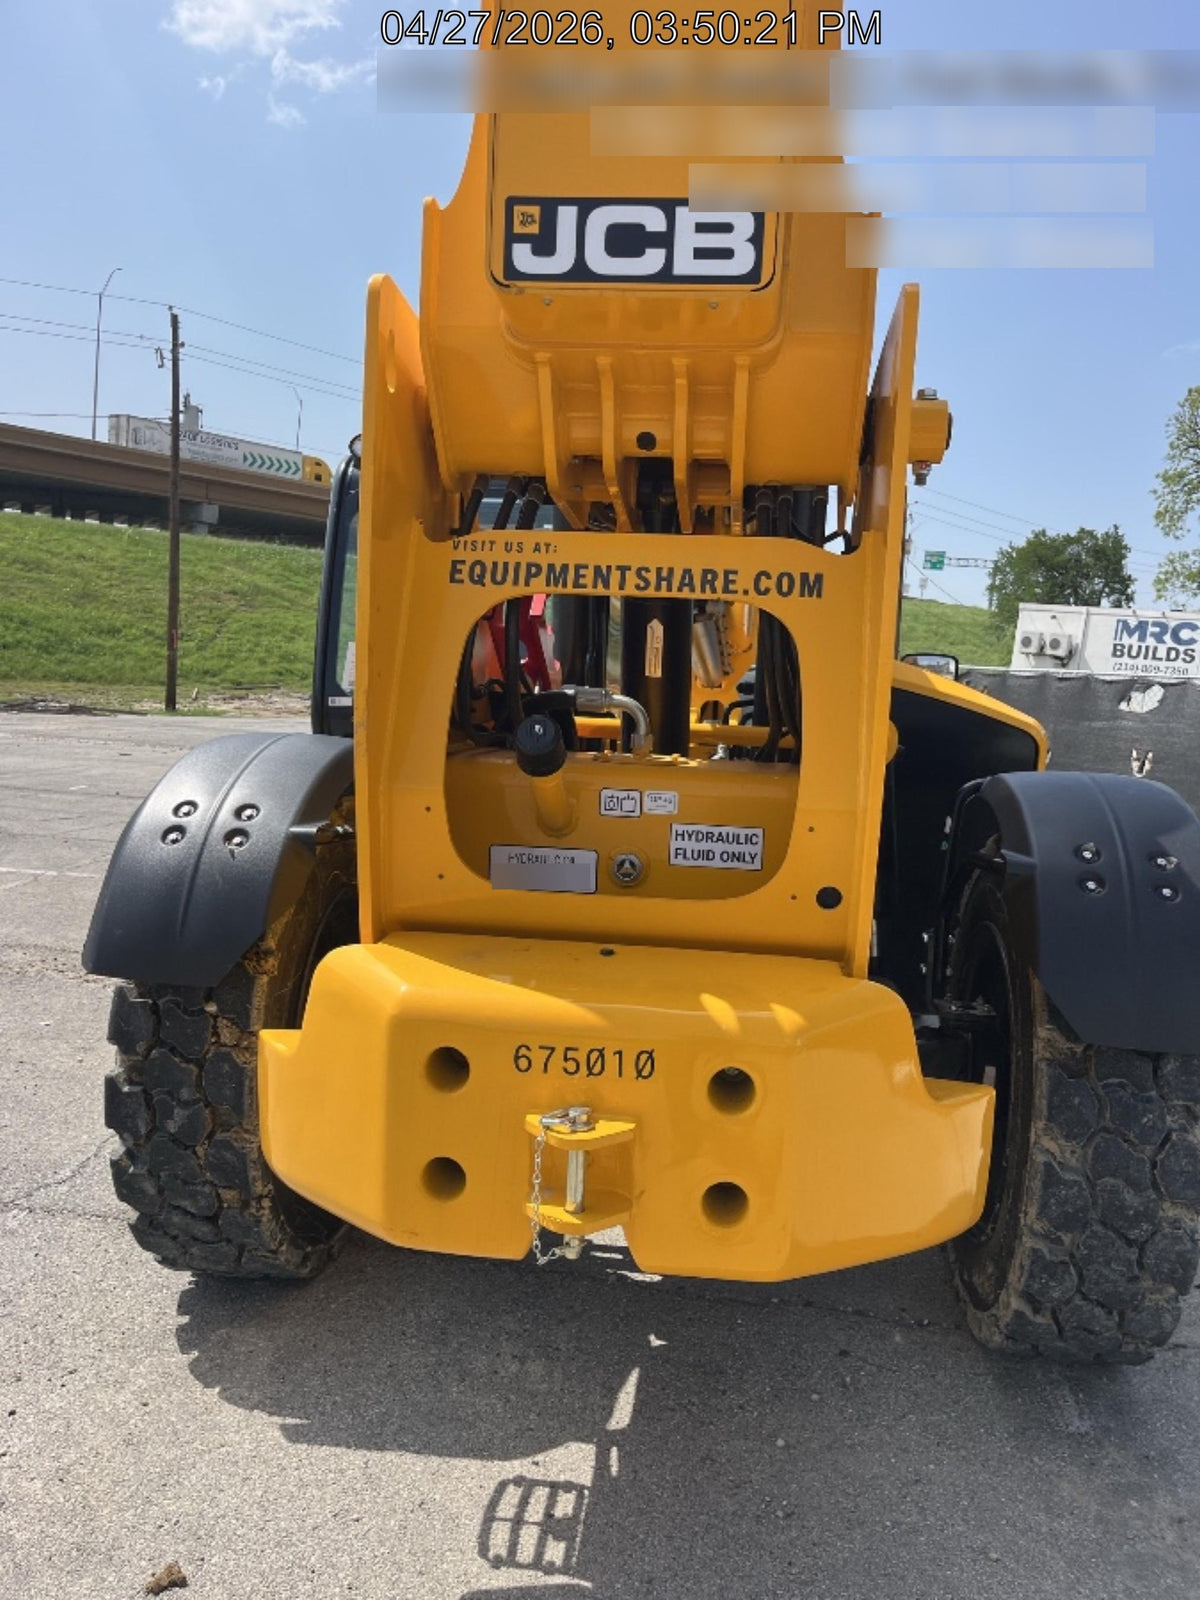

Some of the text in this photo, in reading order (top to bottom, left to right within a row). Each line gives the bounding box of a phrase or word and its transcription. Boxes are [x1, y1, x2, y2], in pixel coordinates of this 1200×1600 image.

[511, 205, 757, 278] JCB
[452, 539, 558, 555] VISIT US AT:
[449, 559, 824, 599] EQUIPMENTSHARE.COM
[1113, 620, 1200, 646] MRC
[1111, 643, 1196, 663] BUILDS
[675, 829, 760, 846] HYDRAULIC
[674, 847, 759, 865] FLUID ONLY
